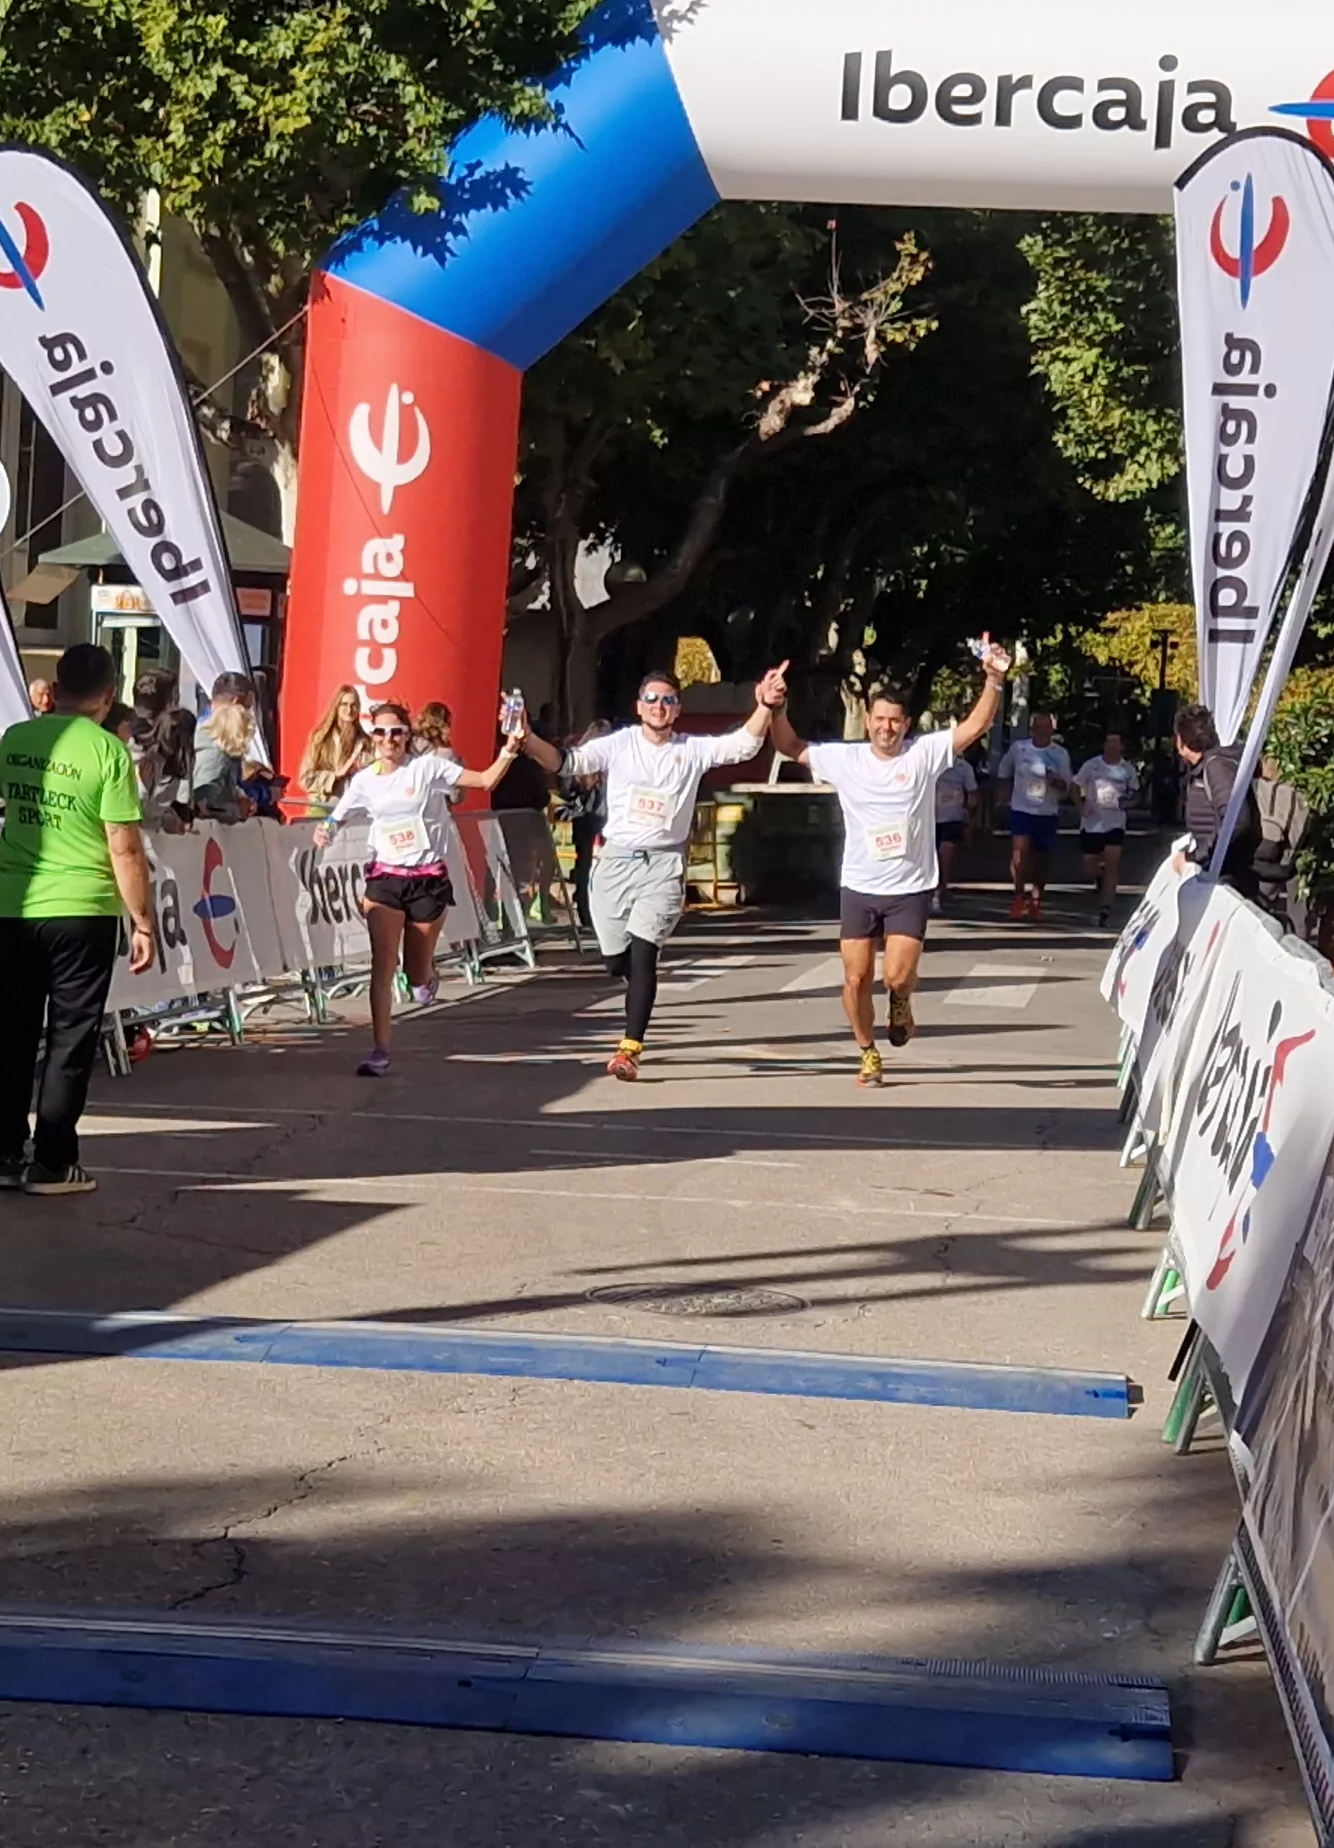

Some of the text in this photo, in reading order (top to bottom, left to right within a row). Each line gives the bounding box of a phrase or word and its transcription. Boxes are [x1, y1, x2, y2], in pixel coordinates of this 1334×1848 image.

[840, 49, 1237, 150] Ibercaja
[18, 804, 62, 831] SPORT
[637, 797, 666, 812] 537
